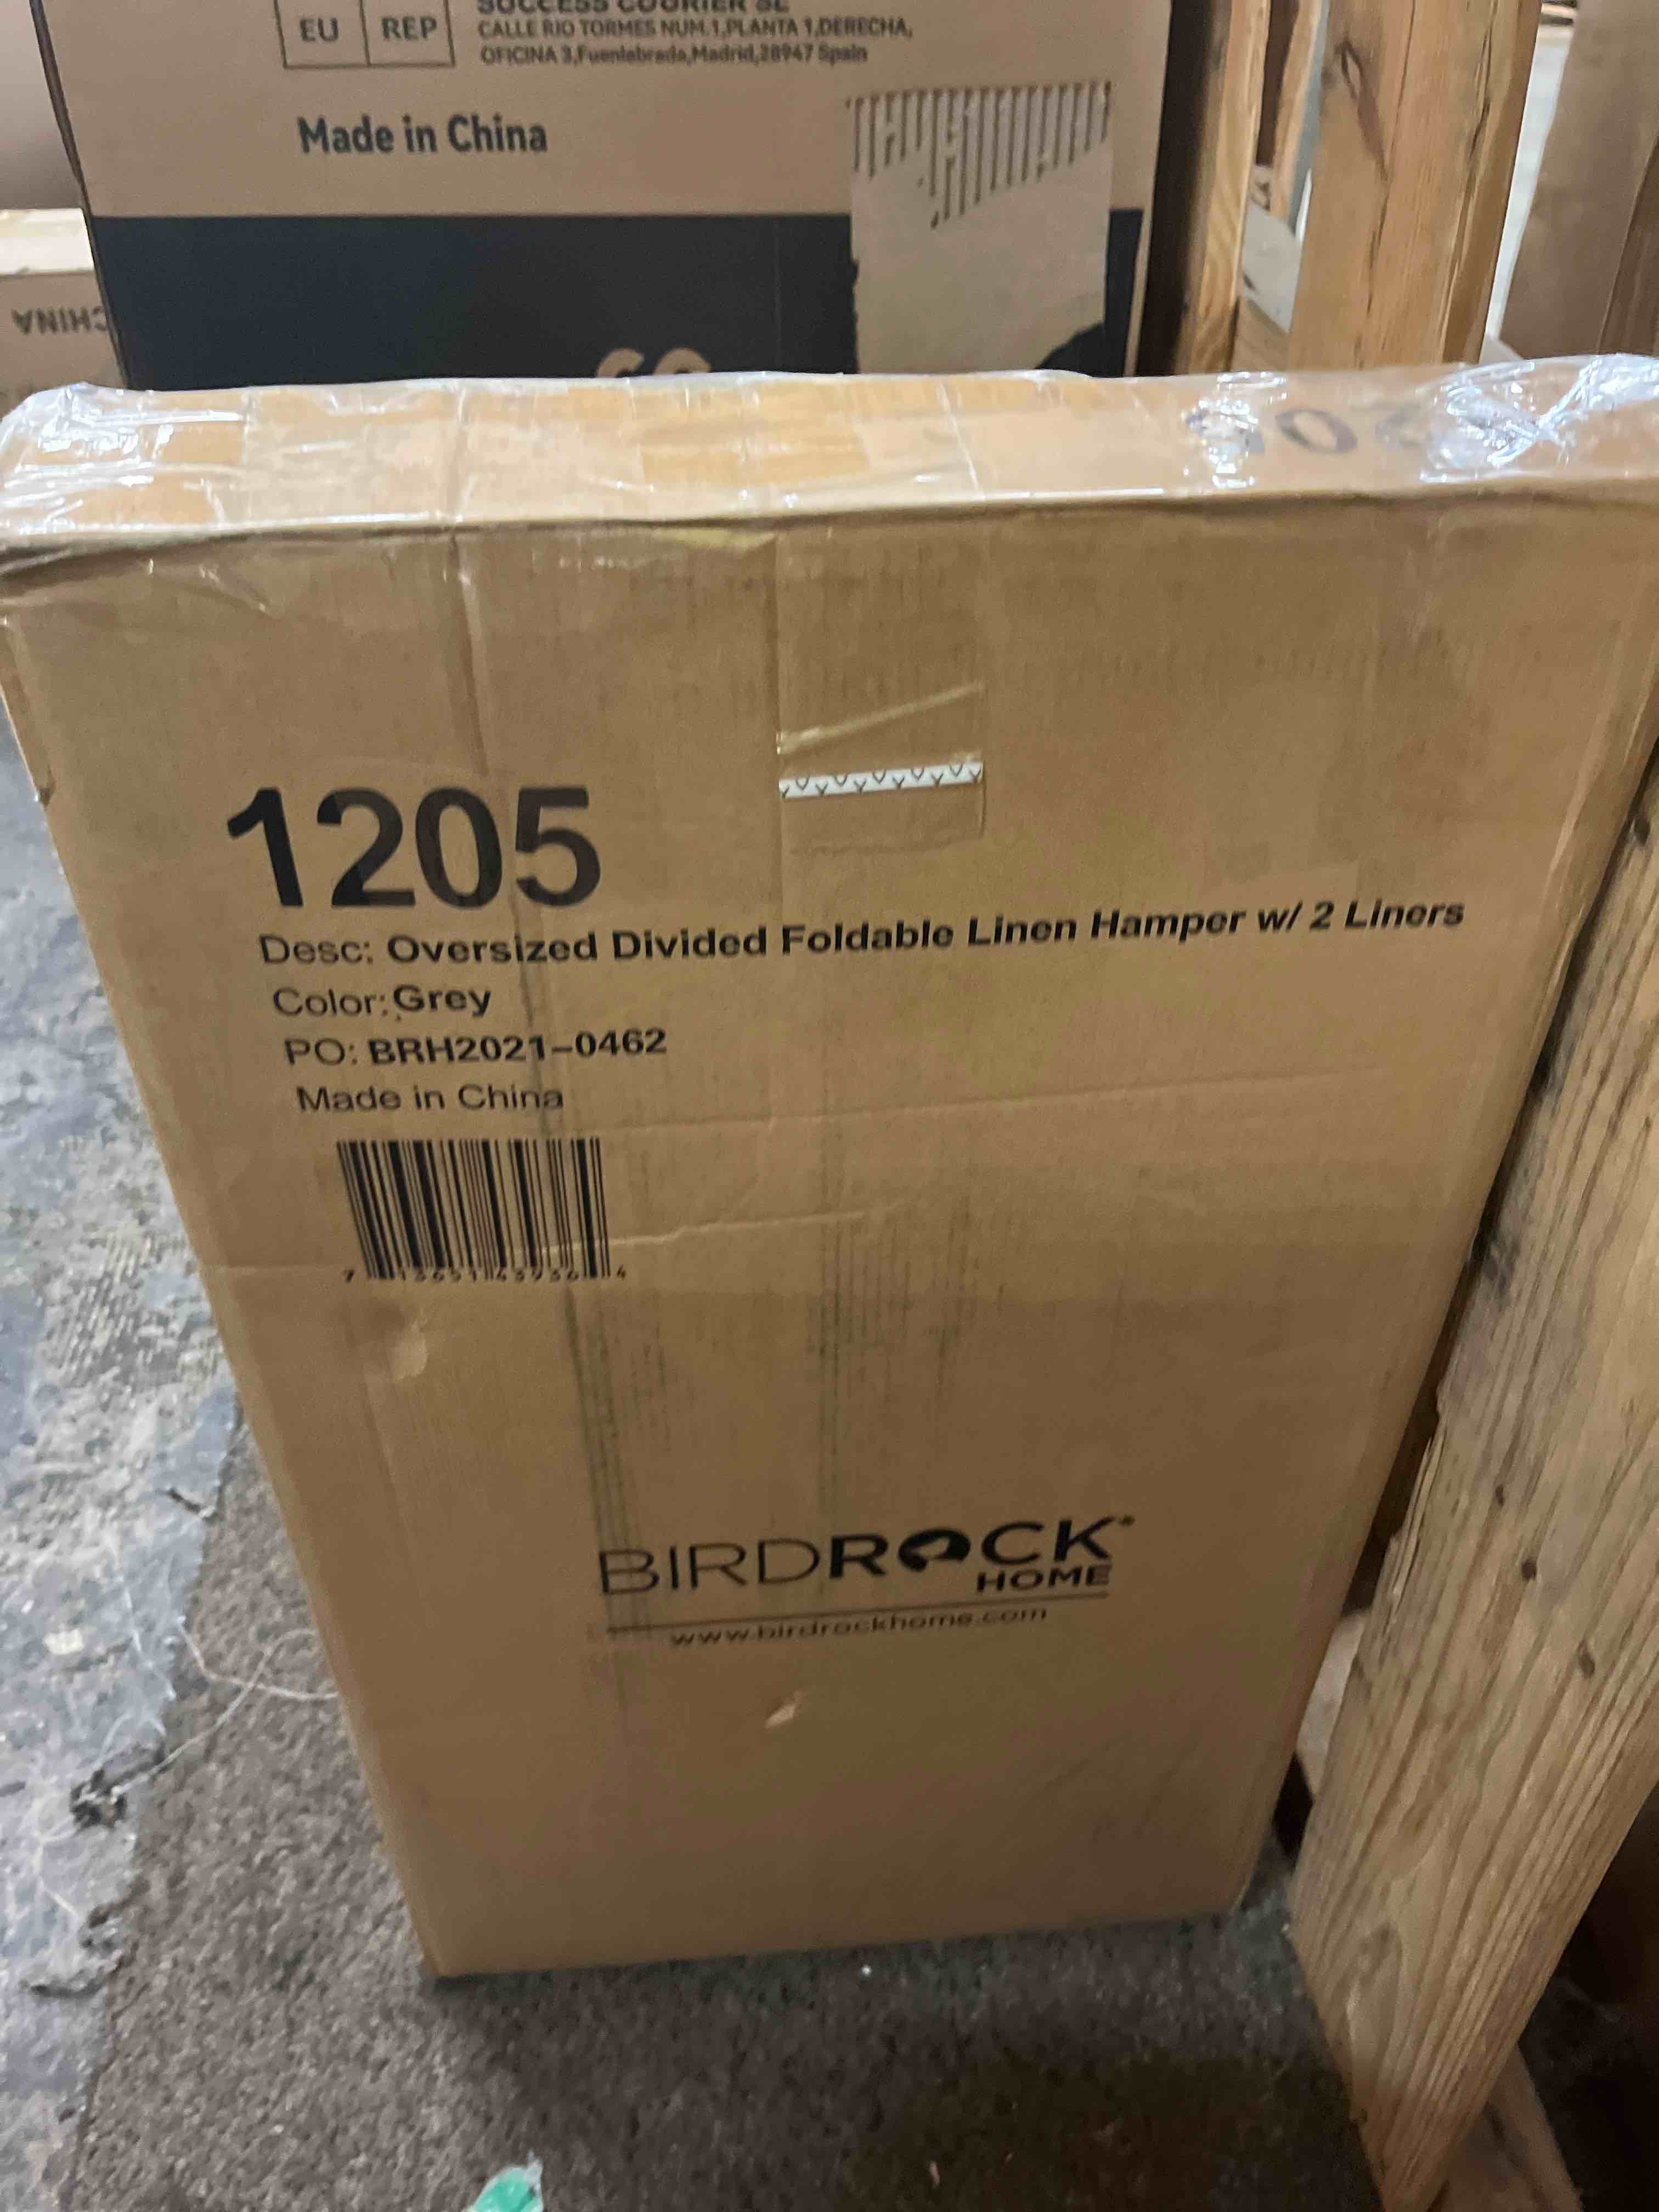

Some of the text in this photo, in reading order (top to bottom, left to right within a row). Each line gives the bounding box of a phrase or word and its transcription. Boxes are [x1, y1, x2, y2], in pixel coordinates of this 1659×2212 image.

[299, 16, 438, 43] EU REP
[477, 19, 536, 38] CALLE
[541, 18, 575, 38] RIO
[579, 18, 656, 37] TORMES
[481, 45, 557, 65] OFICINA
[818, 42, 868, 66] Spain
[297, 113, 549, 154] Made in China
[227, 786, 601, 909] 1205
[258, 898, 1465, 965] Desc: Oversized Divided Foldable Linen Hamper w/ 2 Liners
[273, 984, 492, 1018] Color: Grey
[284, 1028, 668, 1066] PO: BRH2021-0462
[296, 1082, 565, 1112] Made in China
[977, 1563, 1113, 1593] HOME
[670, 1607, 1048, 1646] www.birdrockhome.com
